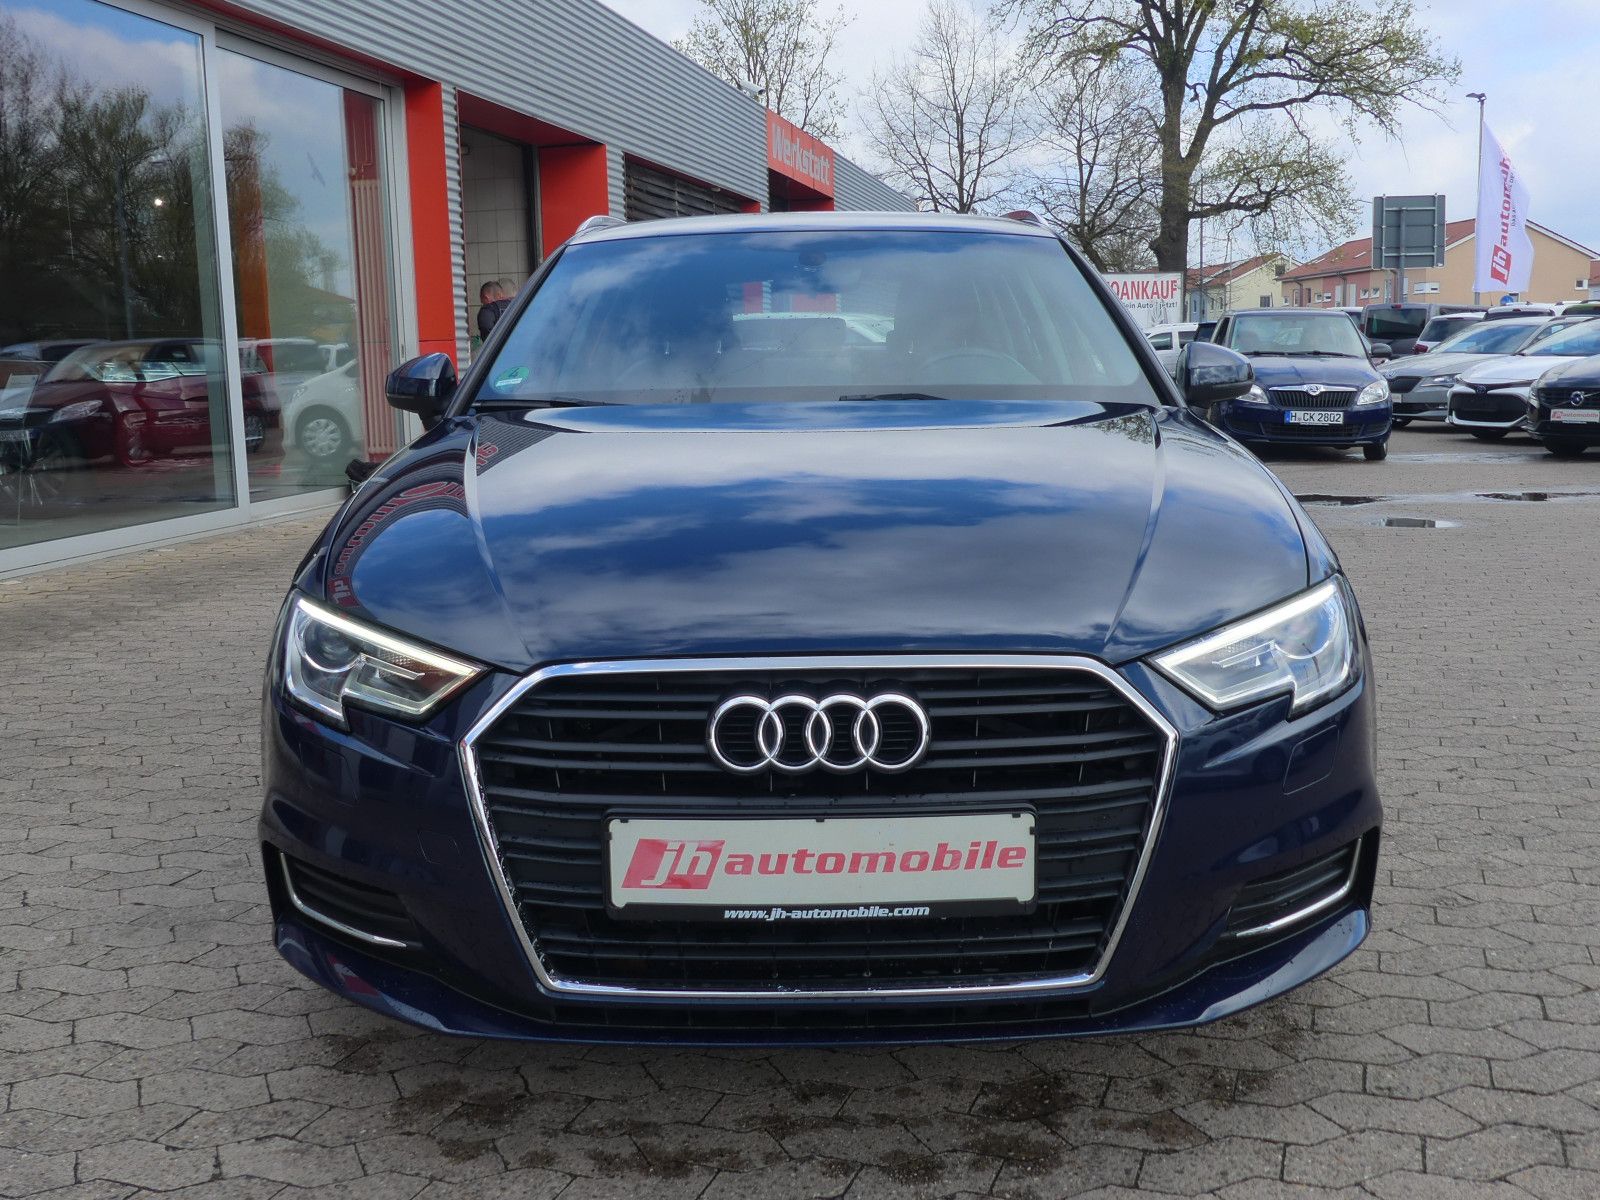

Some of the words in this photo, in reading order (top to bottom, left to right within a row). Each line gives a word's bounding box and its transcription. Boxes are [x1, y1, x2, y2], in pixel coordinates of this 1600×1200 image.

[1290, 412, 1297, 421] H
[1303, 412, 1316, 421] CK
[1317, 412, 1342, 423] 2802
[724, 841, 1027, 875] automobile
[724, 905, 931, 922] www.jh-automobile.com
